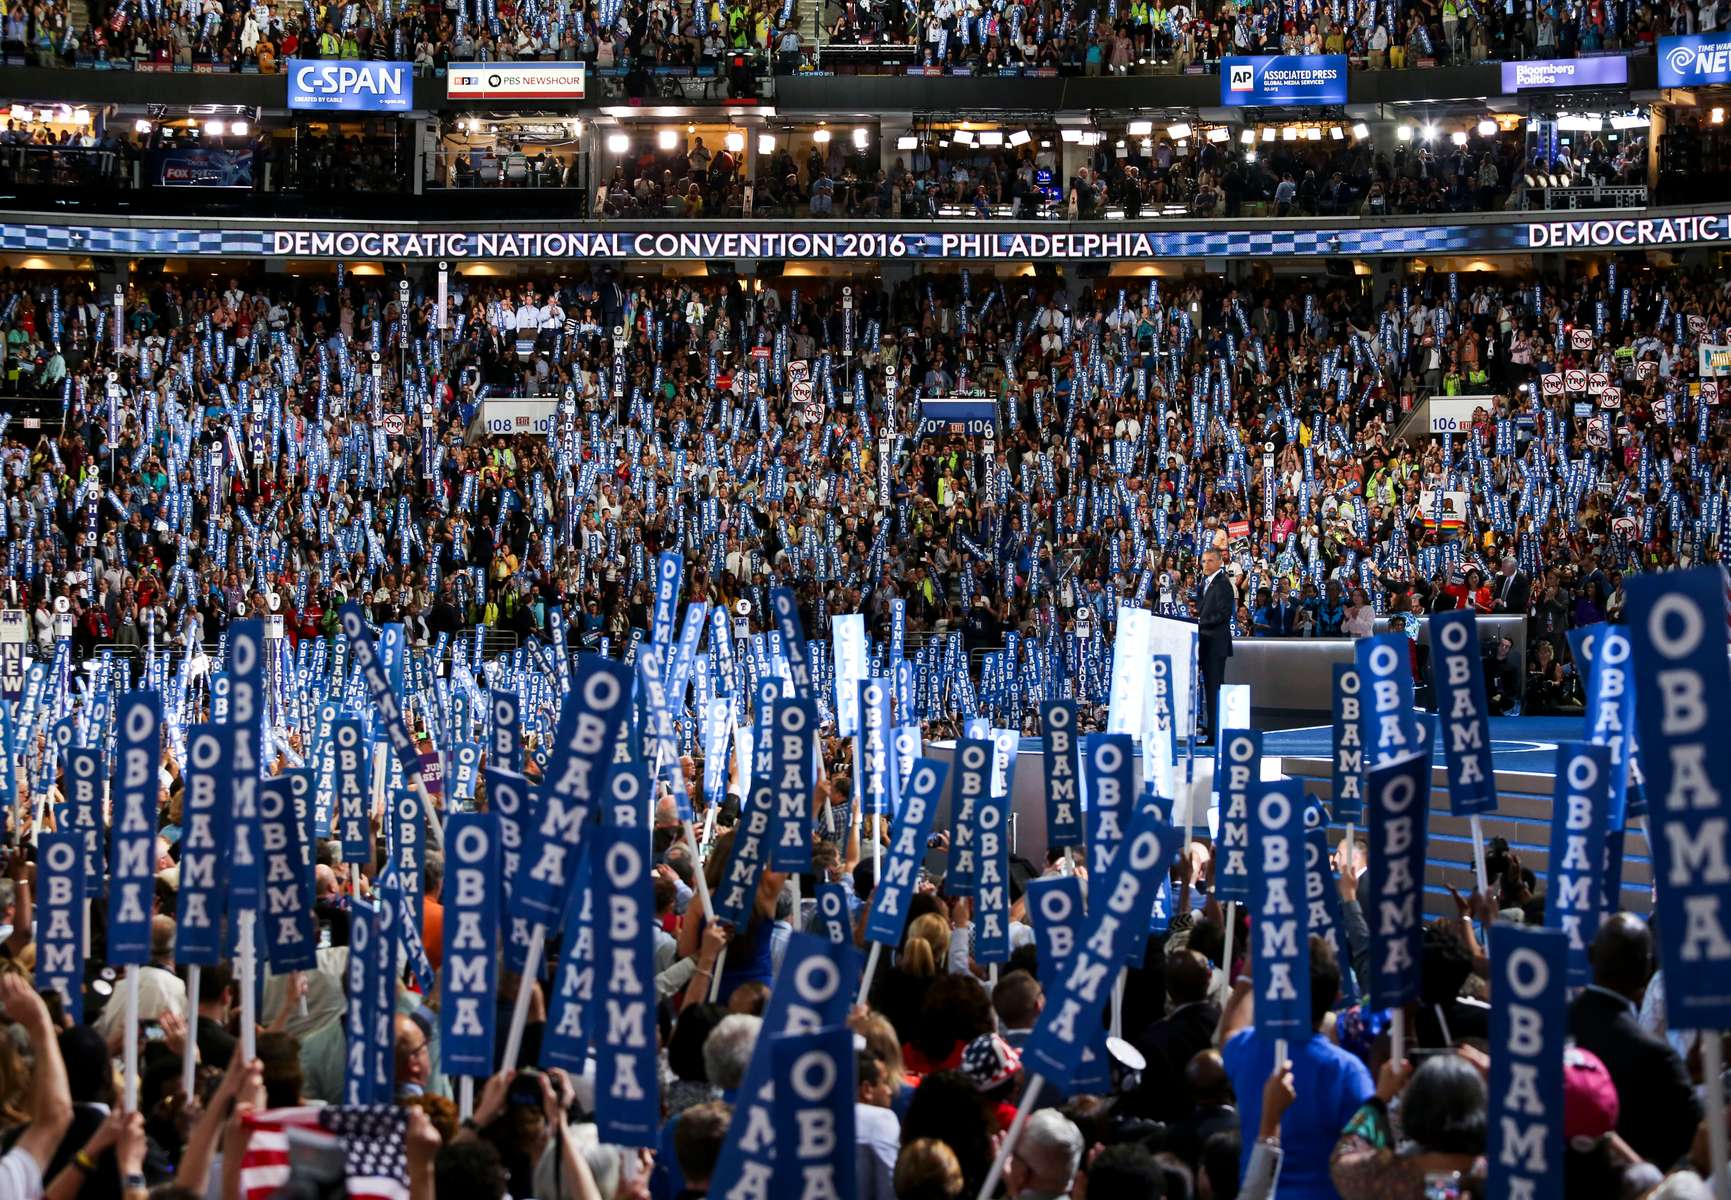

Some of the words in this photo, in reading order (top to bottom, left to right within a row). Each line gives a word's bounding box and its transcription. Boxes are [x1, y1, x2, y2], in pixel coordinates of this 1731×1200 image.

[1516, 64, 1575, 75] Bloomberg
[1696, 51, 1731, 73] NE
[1698, 44, 1716, 52] TIME
[297, 66, 403, 95] C-SPAN
[455, 77, 478, 86] npr
[522, 76, 580, 84] NEWSHOUR
[1233, 72, 1251, 83] AP
[1264, 70, 1311, 80] ASSOCIATED
[1313, 70, 1336, 79] PRESS
[1516, 75, 1556, 85] Politics
[167, 169, 188, 178] FOX
[274, 232, 468, 256] DEMOCRATIC
[477, 233, 626, 256] NATIONAL
[634, 233, 833, 256] CONVENTION
[843, 234, 906, 257] 2016
[942, 233, 1153, 256] PHILADELPHIA
[1529, 216, 1719, 247] DEMOCRATIC
[204, 342, 212, 372] OBAMA
[1339, 370, 1347, 397] OBAMA
[488, 419, 512, 431] 108
[534, 419, 548, 431] 10
[968, 420, 992, 433] 106
[1009, 397, 1017, 425] OBAMA
[1432, 418, 1456, 430] 106
[254, 412, 263, 459] GUAM
[775, 467, 783, 495] OBAMA
[985, 454, 993, 501] ALASKA
[88, 490, 97, 541] OHIO
[536, 494, 544, 520] OBAMA
[1158, 510, 1166, 541] OBAMA
[654, 559, 676, 664] OBAMA
[895, 602, 904, 656] OBAMA
[3, 643, 23, 691] NEW
[332, 643, 346, 697] OBAMA
[552, 613, 570, 691] OBAMA
[713, 611, 735, 691] OBAMA
[812, 648, 820, 690] OBAMA
[17, 667, 42, 741] OBAMA
[274, 638, 282, 727] VIRGINIA
[345, 616, 408, 747] OBAMA
[519, 673, 527, 719] OBAMA
[528, 675, 540, 722] OBAMA
[918, 668, 927, 709] OBAMA
[930, 676, 942, 718] OBAMA
[1441, 621, 1485, 785] OBAMA
[643, 654, 684, 791] OBAMA
[1011, 684, 1020, 729] OBAMA
[233, 634, 256, 865] OBAMA
[863, 687, 885, 795] OBAMA
[1340, 671, 1361, 799] OBAMA
[339, 726, 363, 842] OBAMA
[530, 671, 620, 886] OBAMA
[779, 706, 807, 847] OBAMA
[1049, 706, 1075, 825] OBAMA
[1648, 593, 1731, 961] OBAMA
[117, 703, 155, 923] OBAMA
[183, 733, 221, 928] OBAMA
[1223, 737, 1255, 876] OBAMA
[878, 768, 937, 916] OBAMA
[262, 795, 304, 944] OBAMA
[979, 805, 1002, 939] OBAMA
[1381, 775, 1415, 973] OBAMA
[1257, 793, 1298, 1000] OBAMA
[449, 826, 488, 1036] OBAMA
[1048, 831, 1161, 1042] OBAMA
[606, 842, 647, 1099] OBAMA
